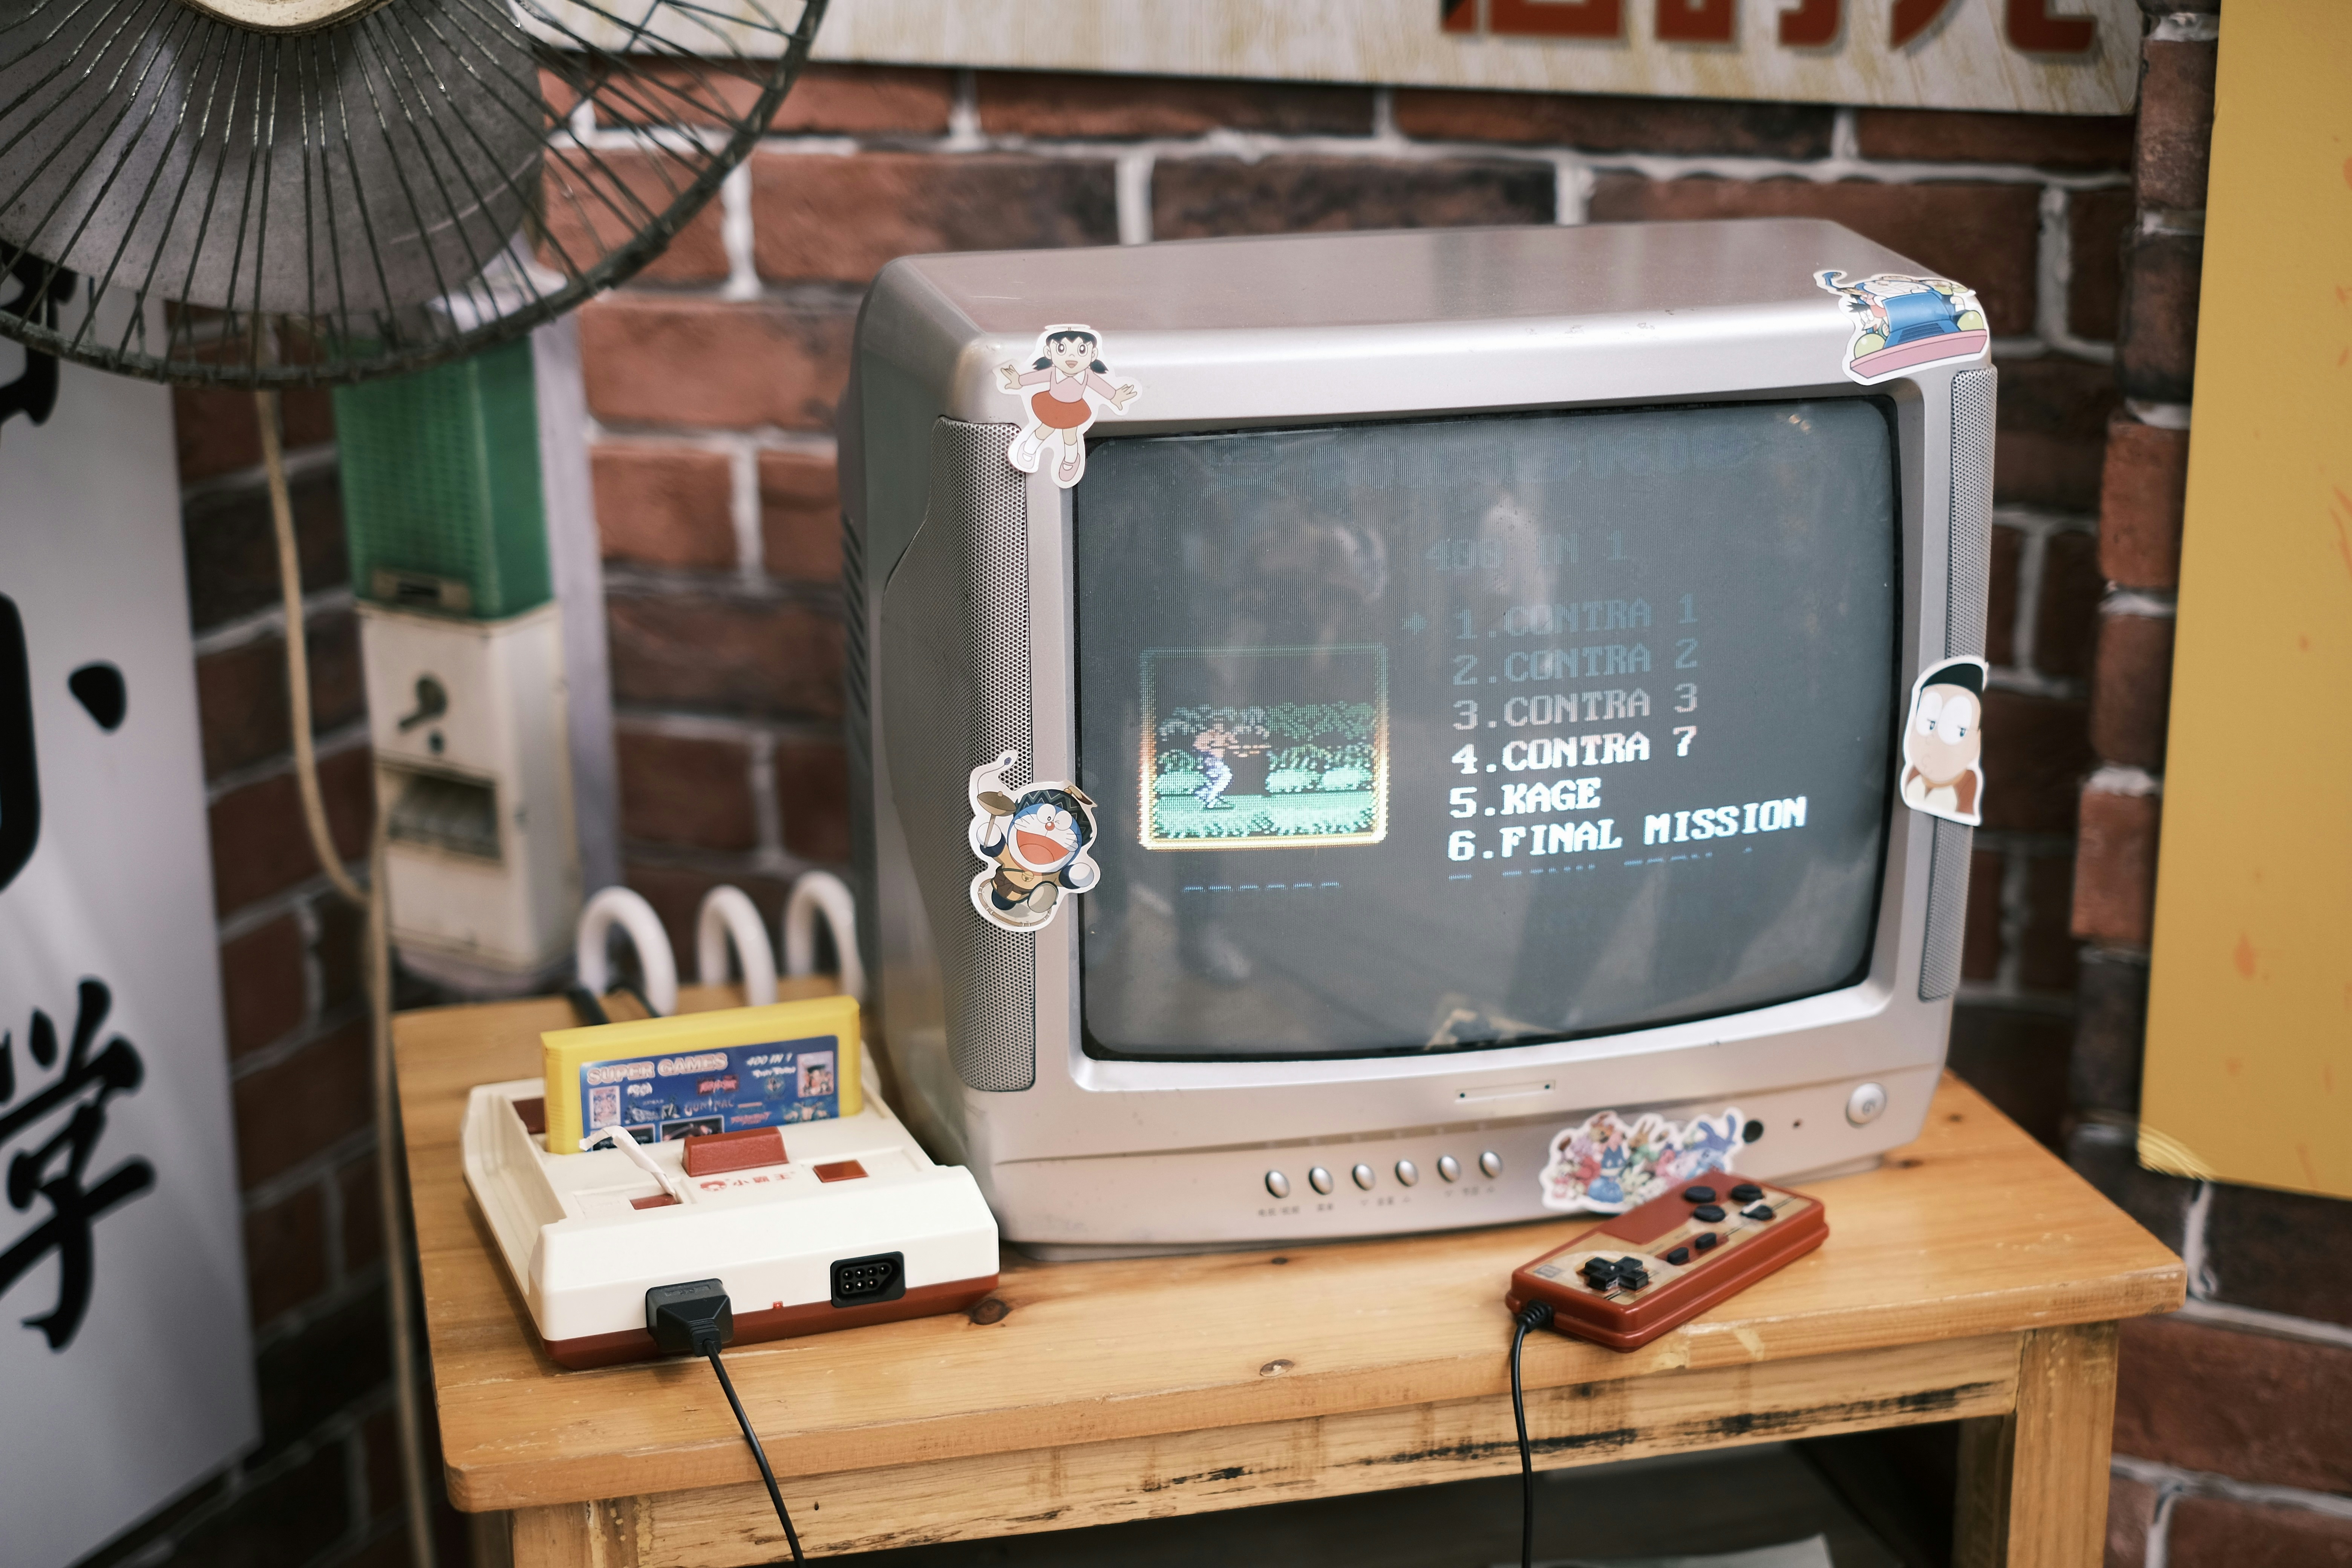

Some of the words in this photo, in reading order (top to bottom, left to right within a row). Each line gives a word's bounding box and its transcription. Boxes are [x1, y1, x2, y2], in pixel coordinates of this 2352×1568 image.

[1536, 532, 1581, 567] IN
[1606, 528, 1628, 562] 1
[1455, 597, 1652, 640] 1.CONTRA
[1678, 593, 1698, 624] 1
[1453, 643, 1651, 685] 2.CONTRA
[1675, 638, 1698, 669] 2
[1453, 688, 1650, 730] 3.CONTRA
[1674, 683, 1698, 713] 3
[1451, 731, 1650, 774] 4.CONTRA
[1672, 725, 1697, 757] 7
[1449, 777, 1601, 818] 5.KAGE
[1447, 818, 1622, 861] 6.FINAL
[1643, 796, 1808, 845] MISSION
[587, 1061, 655, 1085] SUPER
[657, 1052, 728, 1077] GAMES
